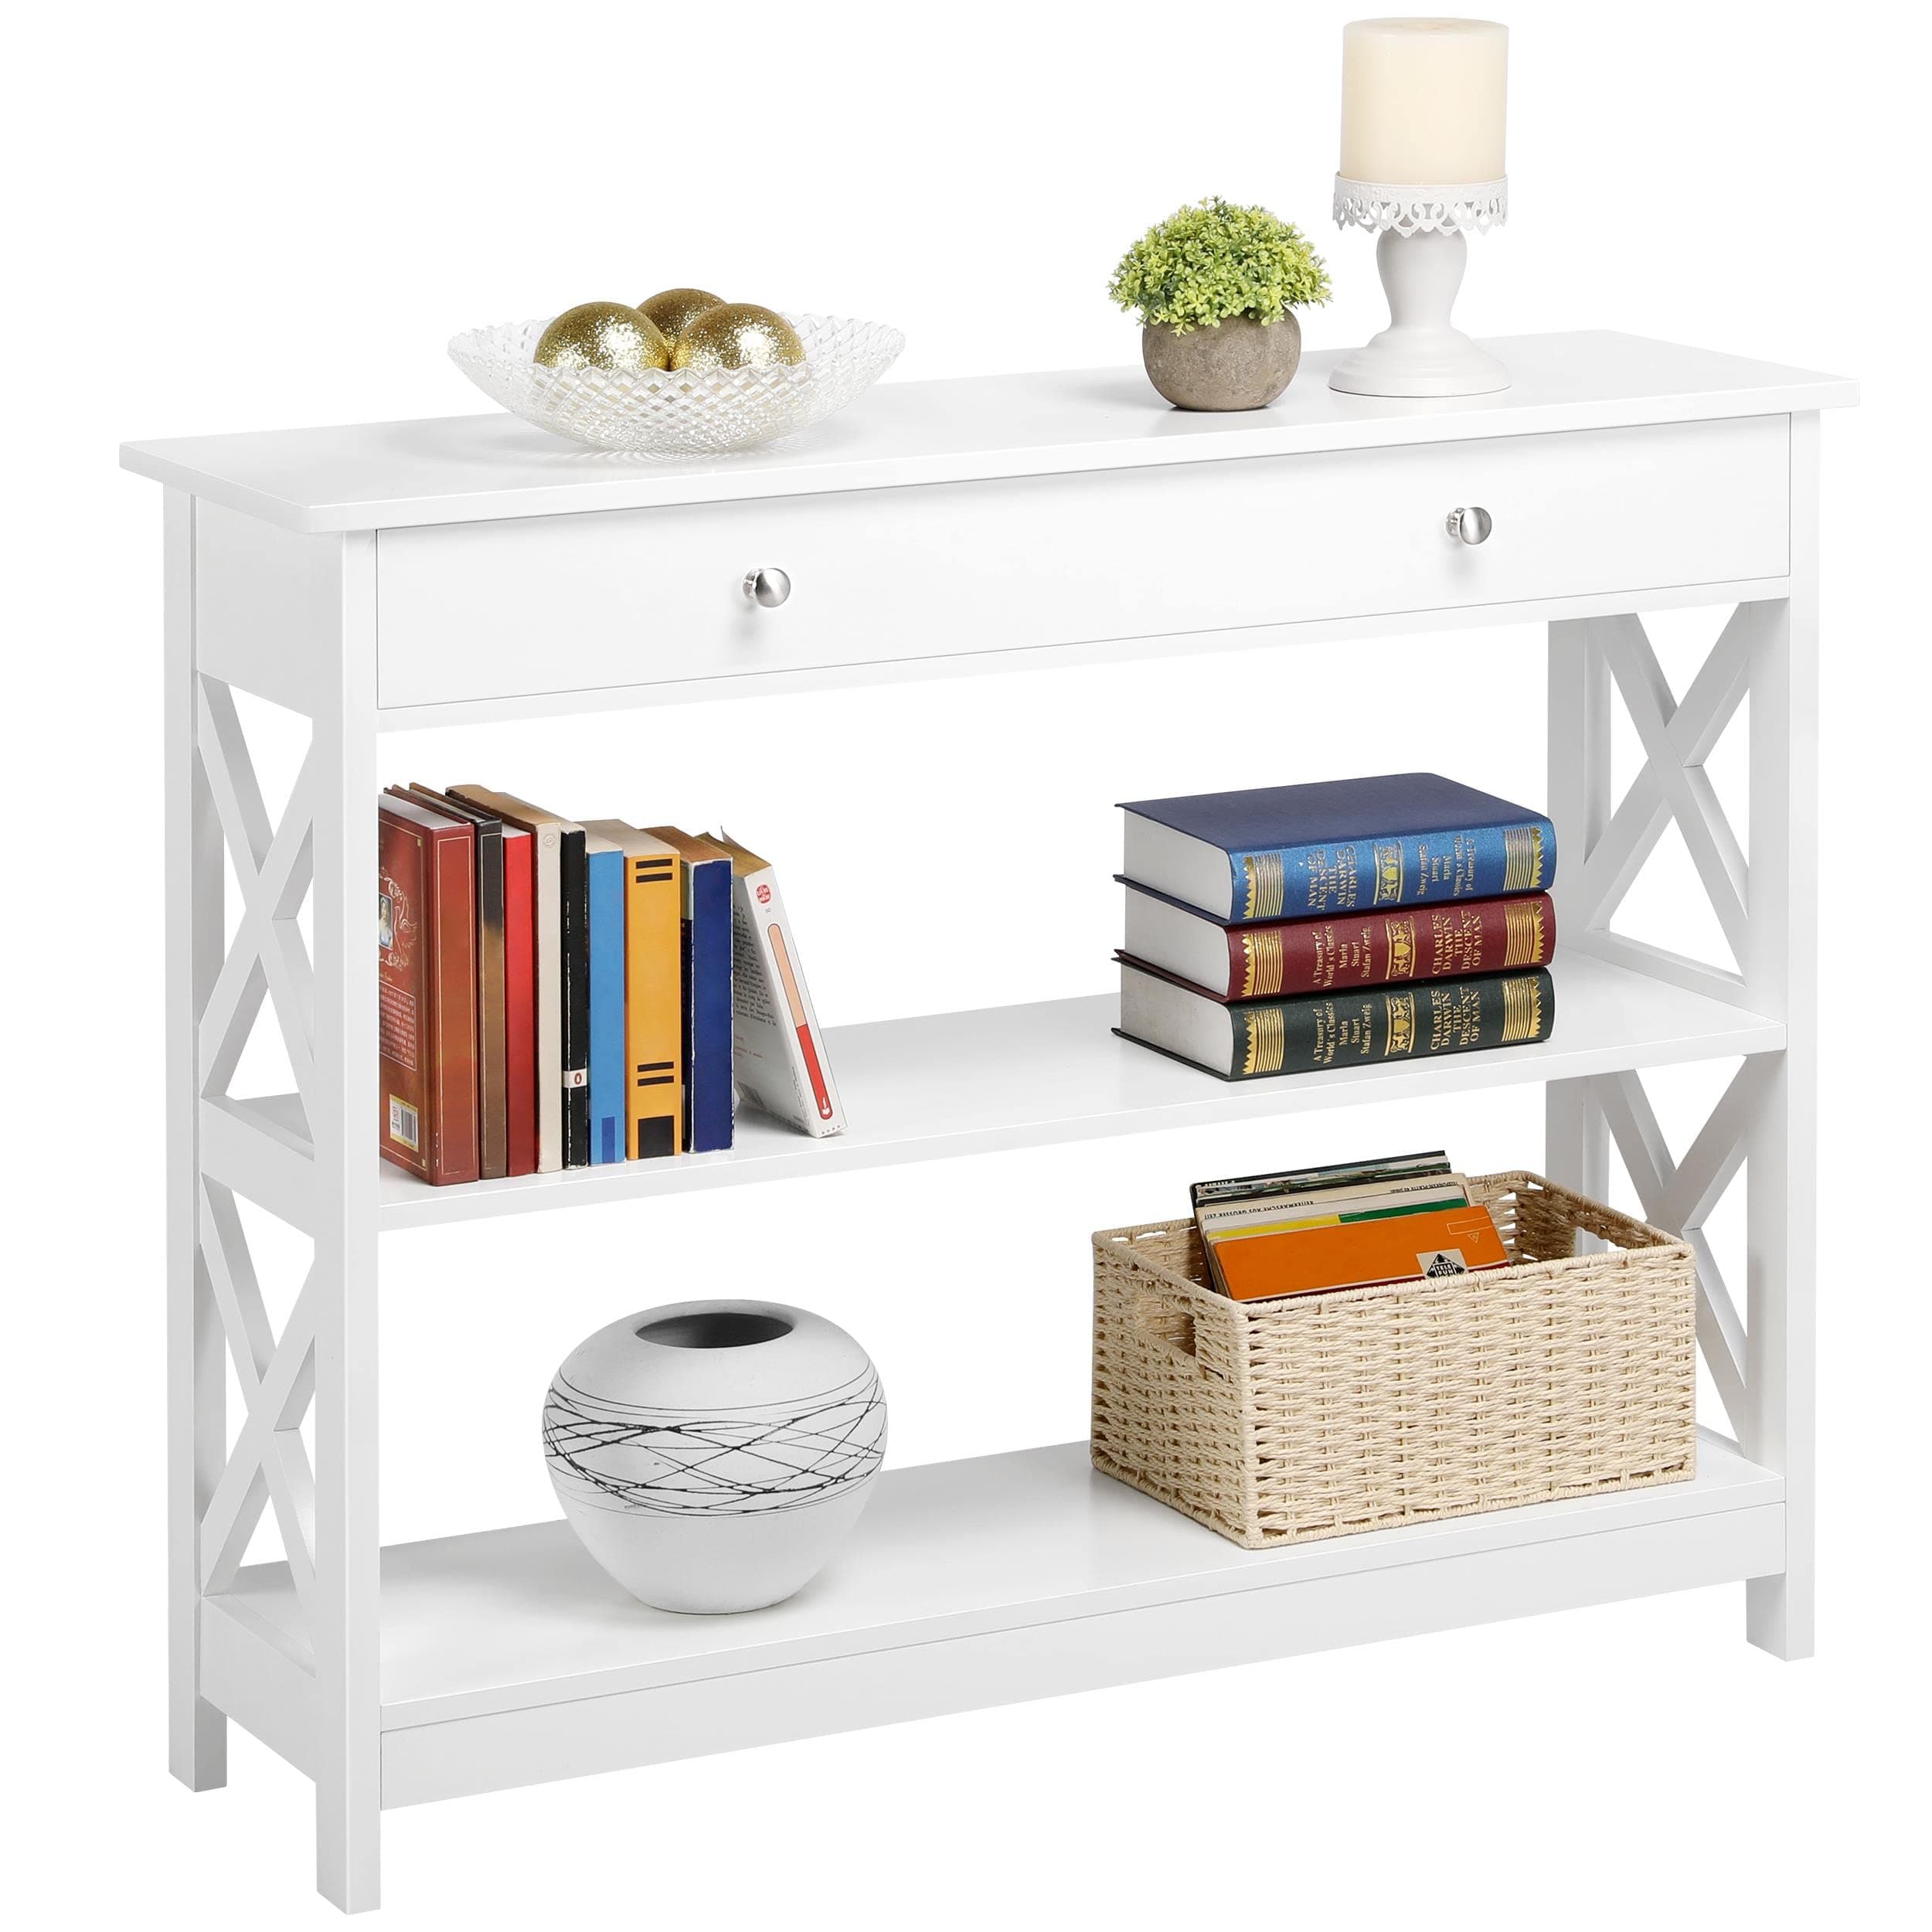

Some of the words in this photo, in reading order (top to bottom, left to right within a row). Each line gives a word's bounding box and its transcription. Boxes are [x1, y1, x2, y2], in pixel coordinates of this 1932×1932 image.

[1307, 853, 1317, 872] OF
[1336, 849, 1347, 905] DARWIN
[1346, 845, 1358, 908] CHARLES
[1431, 856, 1440, 883] Stuart
[1308, 876, 1318, 906] MAN
[1316, 849, 1328, 910] DESCENT
[1328, 865, 1338, 894] THE
[1417, 872, 1429, 895] Zweig
[1454, 869, 1465, 896] Classics
[1465, 883, 1474, 892] of
[1360, 927, 1372, 952] Zweig
[1431, 914, 1444, 974] CHARLES
[1442, 917, 1454, 970] DARWIN
[1454, 929, 1464, 957] THE
[1461, 910, 1473, 970] DESCENT
[1471, 915, 1483, 947] MAN
[1314, 941, 1325, 978] Treasury
[1351, 941, 1360, 967] Stuart
[1471, 949, 1481, 966] OF
[1313, 1009, 1323, 1017] of
[1325, 1002, 1336, 1032] Classics
[1361, 1004, 1372, 1029] Zweig
[1430, 990, 1443, 1050] CHARLES
[1440, 992, 1453, 1046] DARWIN
[1453, 1005, 1463, 1033] THE
[1459, 986, 1471, 1046] DESCENT
[1470, 991, 1481, 1022] MAN
[1314, 1019, 1326, 1055] Treasury
[1351, 1018, 1360, 1043] Stuart
[1470, 1025, 1481, 1042] OF
